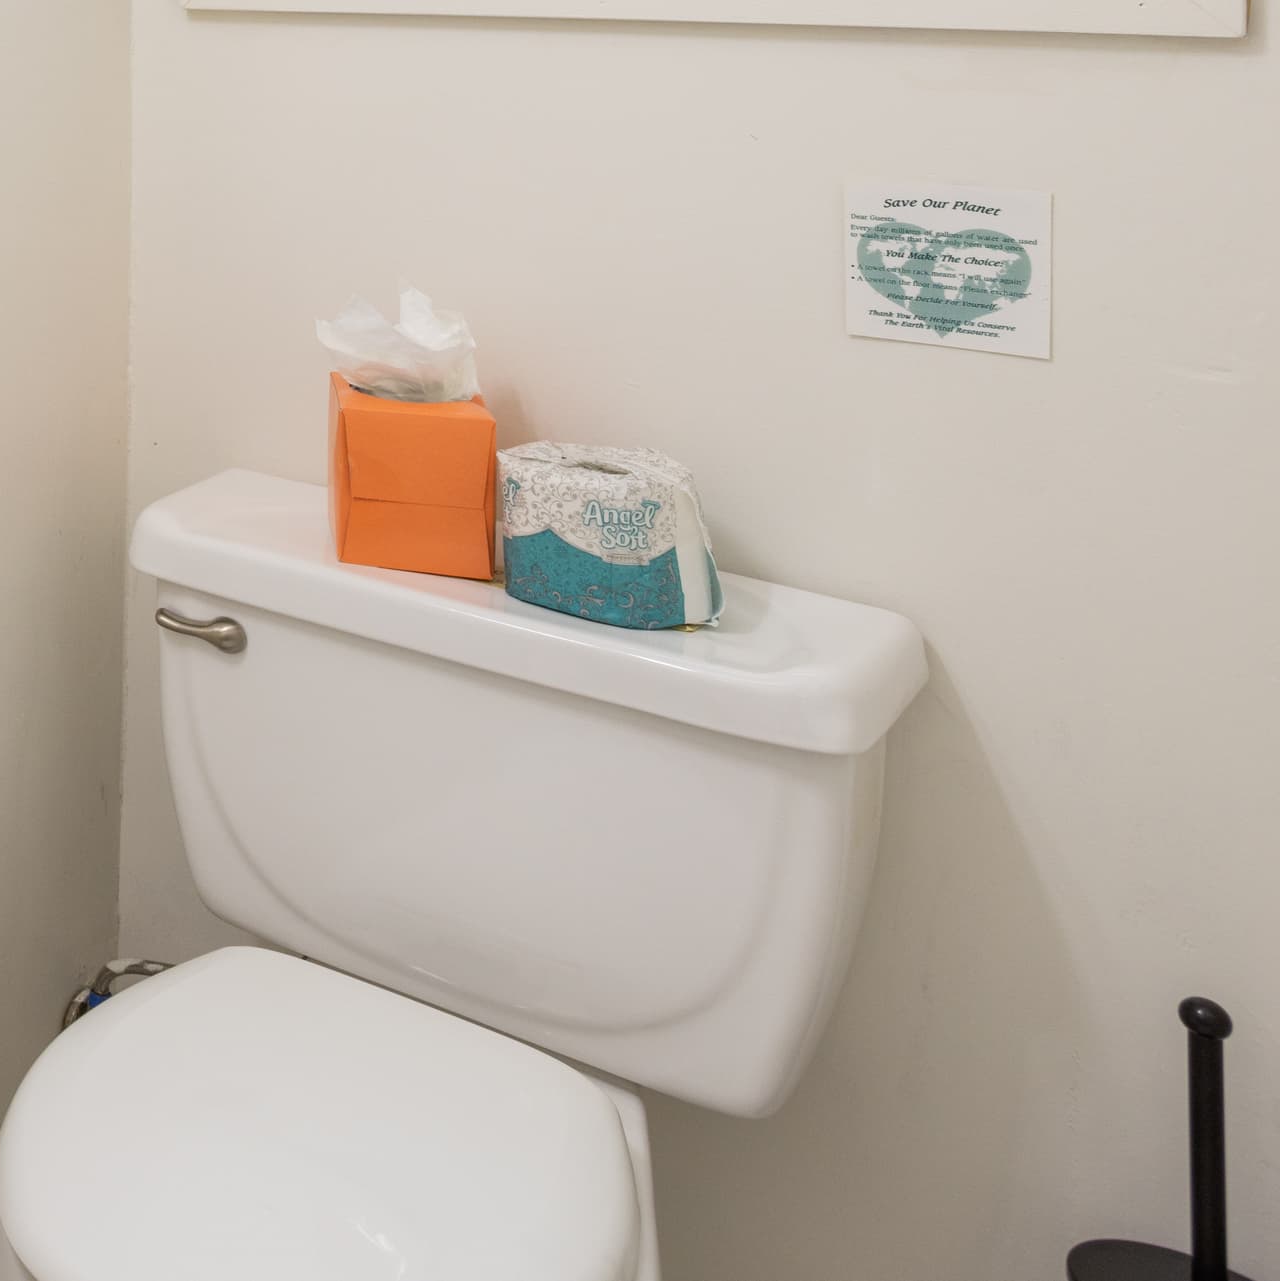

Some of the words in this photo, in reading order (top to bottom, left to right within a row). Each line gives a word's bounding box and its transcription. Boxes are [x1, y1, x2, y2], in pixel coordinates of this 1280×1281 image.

[883, 198, 918, 209] Save
[922, 198, 950, 209] Our
[951, 200, 1002, 216] Planet
[850, 213, 868, 221] Dear
[850, 224, 872, 233] Every
[874, 224, 889, 234] day
[891, 227, 922, 236] millions
[935, 231, 963, 239] gallons
[976, 234, 999, 242] water
[860, 232, 880, 240] wash
[881, 234, 906, 242] towels
[963, 240, 982, 248] been
[984, 242, 1003, 250] used
[885, 249, 905, 259] You
[907, 251, 938, 261] Make
[941, 254, 961, 264] The
[963, 256, 1005, 268] Choice:
[864, 264, 886, 272] towel
[931, 271, 957, 279] means
[932, 283, 958, 291] means
[886, 292, 914, 301] Please
[915, 295, 943, 304] Decide
[868, 309, 894, 318] Thank
[896, 312, 913, 320] You
[929, 316, 962, 326] Helping
[977, 321, 1016, 332] Conserve
[582, 500, 656, 532] Angel
[600, 524, 648, 551] Soft
